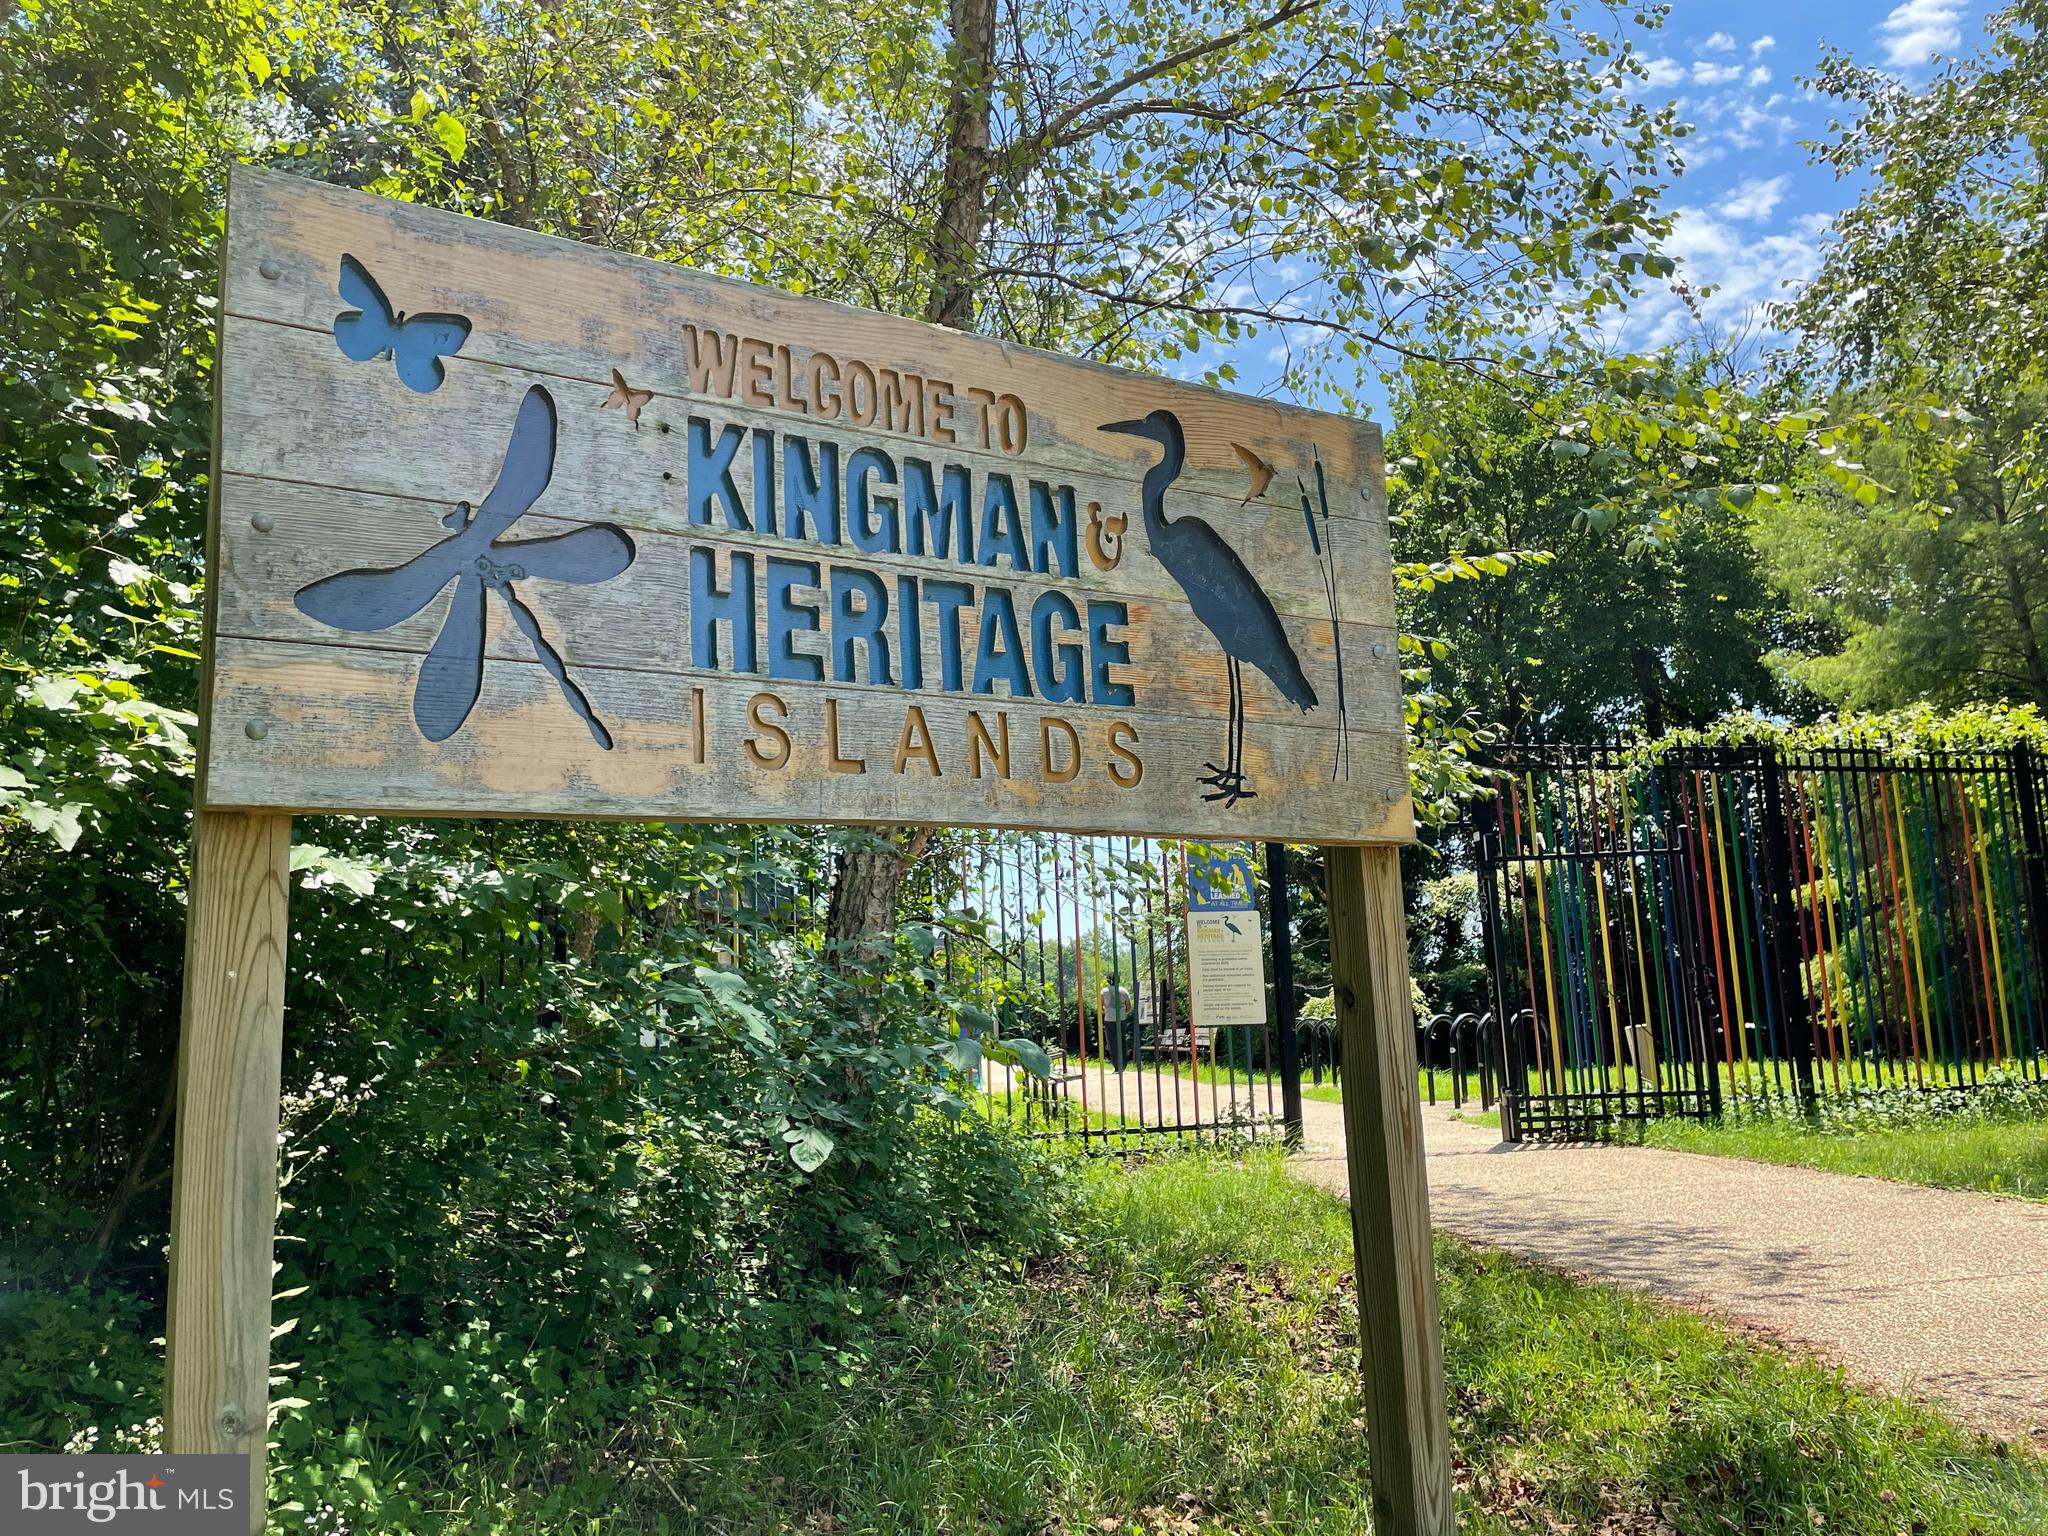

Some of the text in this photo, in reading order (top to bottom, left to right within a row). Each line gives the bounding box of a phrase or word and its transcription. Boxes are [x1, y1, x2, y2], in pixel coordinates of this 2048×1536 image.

[683, 324, 1028, 456] WELCOME TO
[687, 416, 1128, 579] KINGMAN &
[689, 545, 1135, 706] HERITAGE
[692, 688, 1143, 788] ISLANDS
